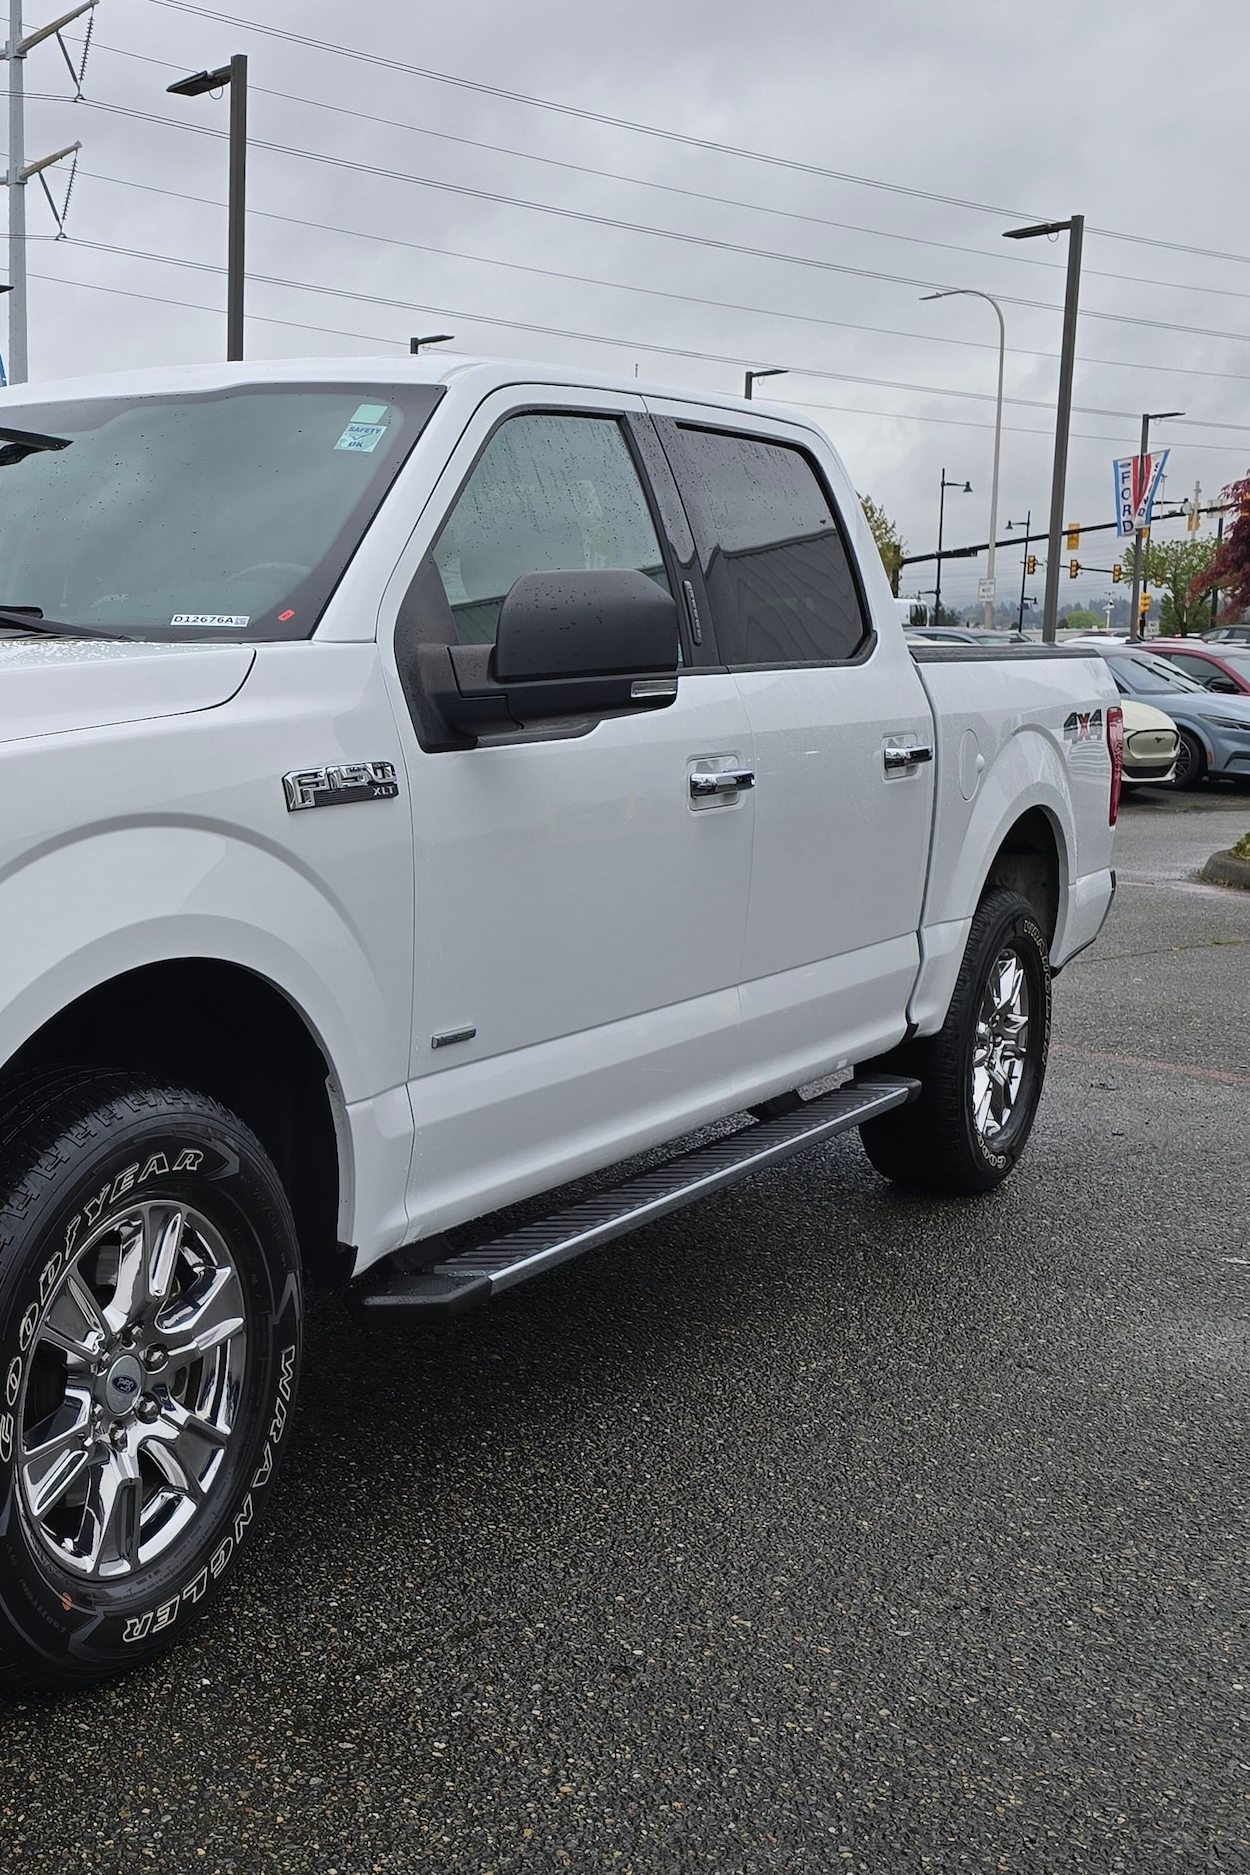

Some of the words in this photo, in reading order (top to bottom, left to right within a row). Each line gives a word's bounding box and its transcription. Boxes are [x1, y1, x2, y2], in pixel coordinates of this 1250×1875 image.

[349, 426, 381, 434] SAFETY
[1121, 470, 1134, 533] FORD
[174, 615, 234, 625] D12676A
[373, 785, 395, 797] XLT
[122, 1344, 296, 1643] WRANGLER
